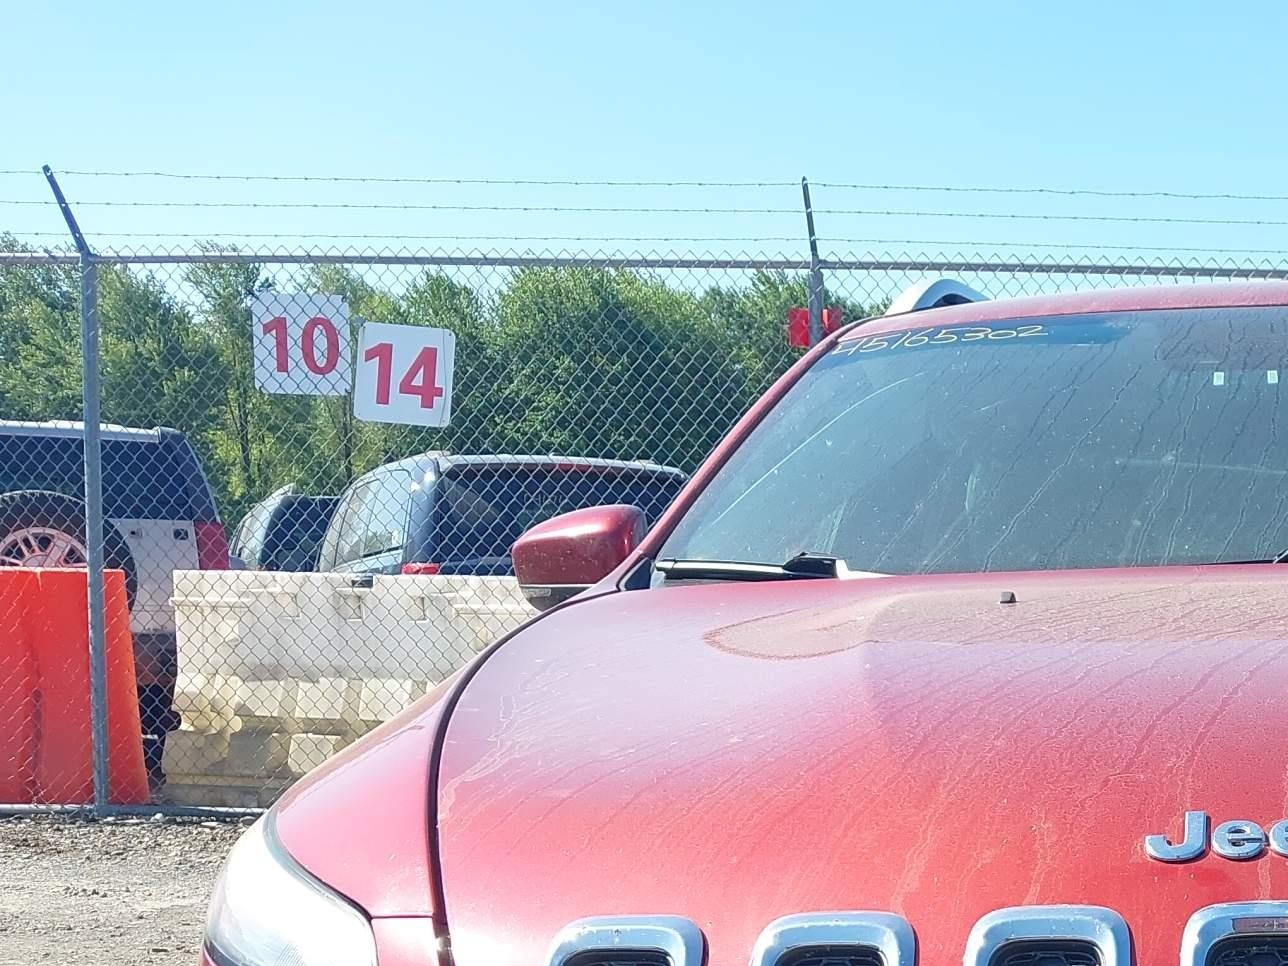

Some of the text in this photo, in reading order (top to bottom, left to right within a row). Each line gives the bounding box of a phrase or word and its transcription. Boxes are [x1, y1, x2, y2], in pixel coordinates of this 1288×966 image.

[261, 315, 340, 376] 10
[831, 324, 1049, 356] 45165302
[363, 342, 444, 410] 14
